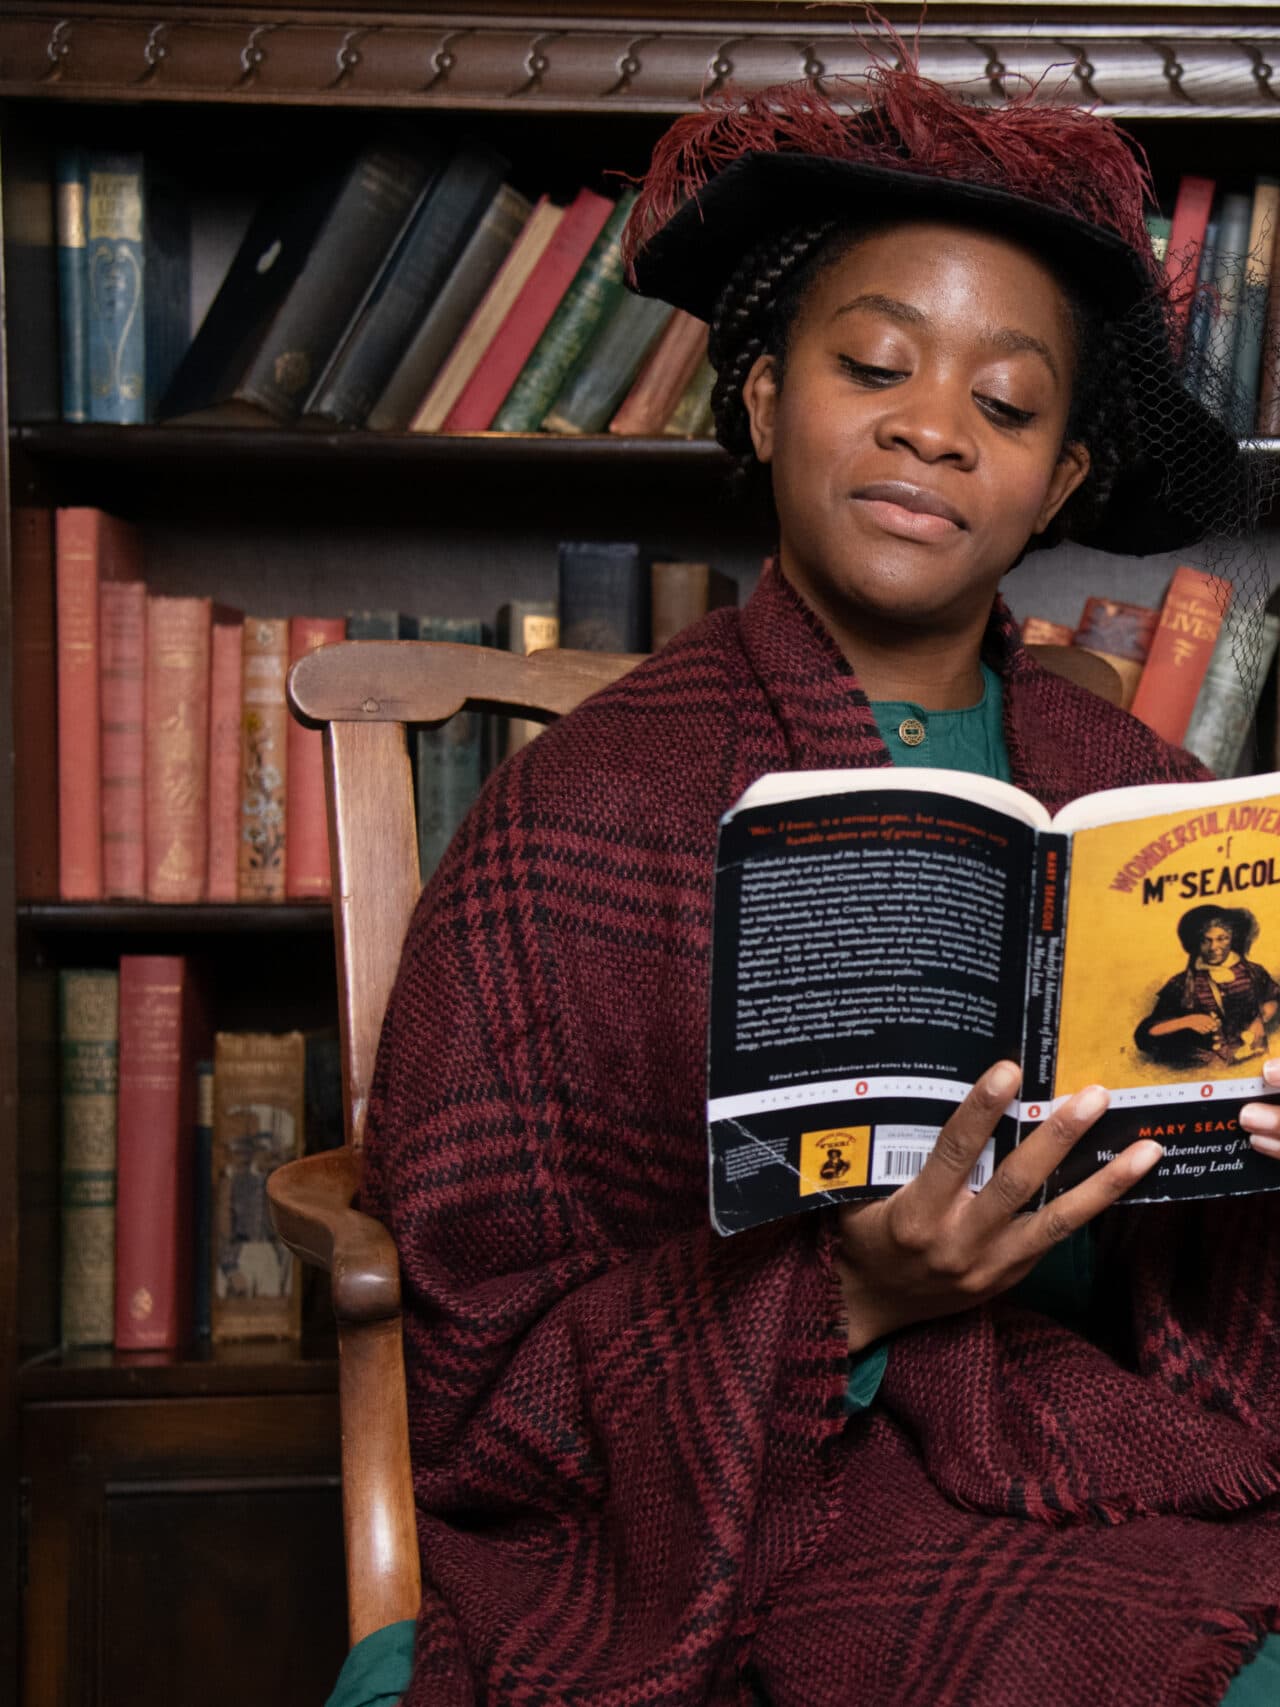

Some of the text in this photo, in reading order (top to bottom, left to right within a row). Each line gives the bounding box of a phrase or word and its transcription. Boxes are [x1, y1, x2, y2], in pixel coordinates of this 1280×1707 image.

[1109, 811, 1224, 893] WONDERFUL
[1119, 1090, 1184, 1102] ENGUIN
[1138, 1119, 1238, 1137] MARY SEAC
[1224, 1139, 1238, 1154] of
[1158, 1158, 1244, 1177] in Many Lands
